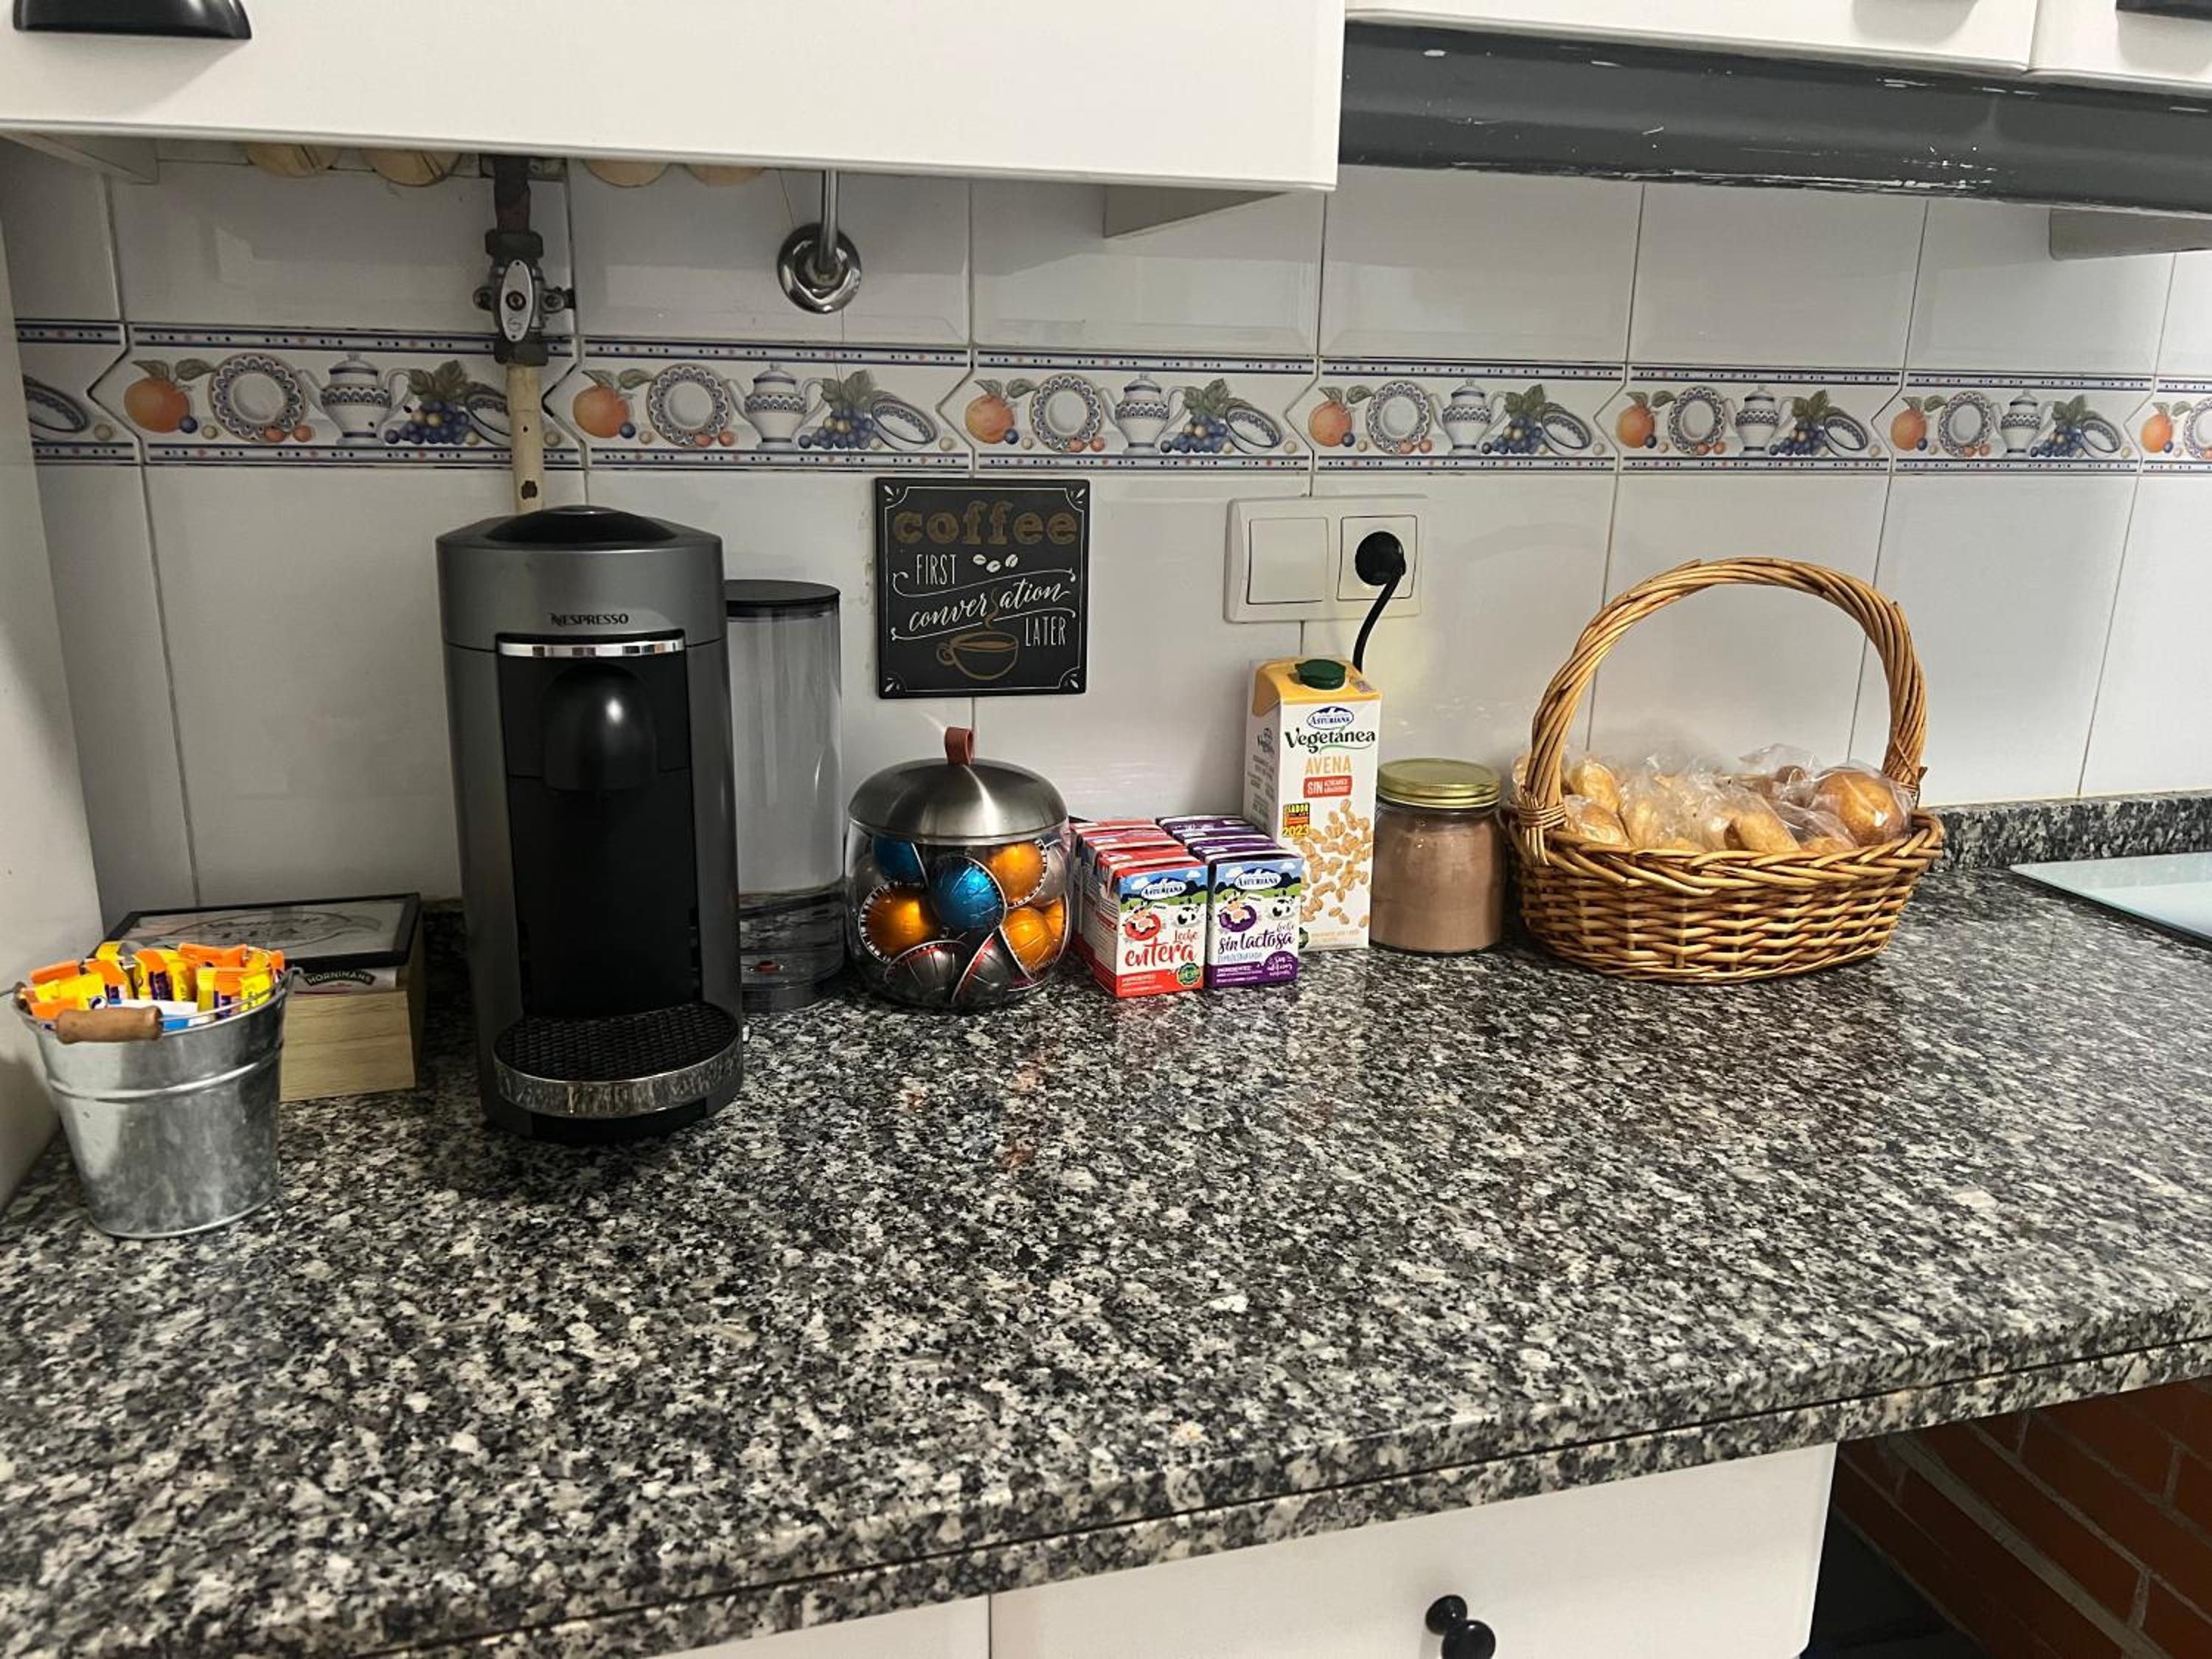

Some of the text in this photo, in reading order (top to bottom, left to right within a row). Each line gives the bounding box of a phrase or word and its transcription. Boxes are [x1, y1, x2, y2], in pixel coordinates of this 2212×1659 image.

[893, 501, 1077, 546] coffee
[916, 554, 957, 585] FIRST
[550, 613, 629, 627] NESPRESSO
[1025, 616, 1067, 647] LATER
[1311, 715, 1350, 726] ASTURIANA
[1284, 726, 1376, 754] Vegetánea
[1304, 755, 1352, 775] AVENA
[1307, 781, 1324, 795] SIN
[1282, 824, 1310, 837] 2023
[1124, 936, 1196, 967] entera
[1217, 936, 1239, 954] sin
[1239, 930, 1295, 950] lactosa
